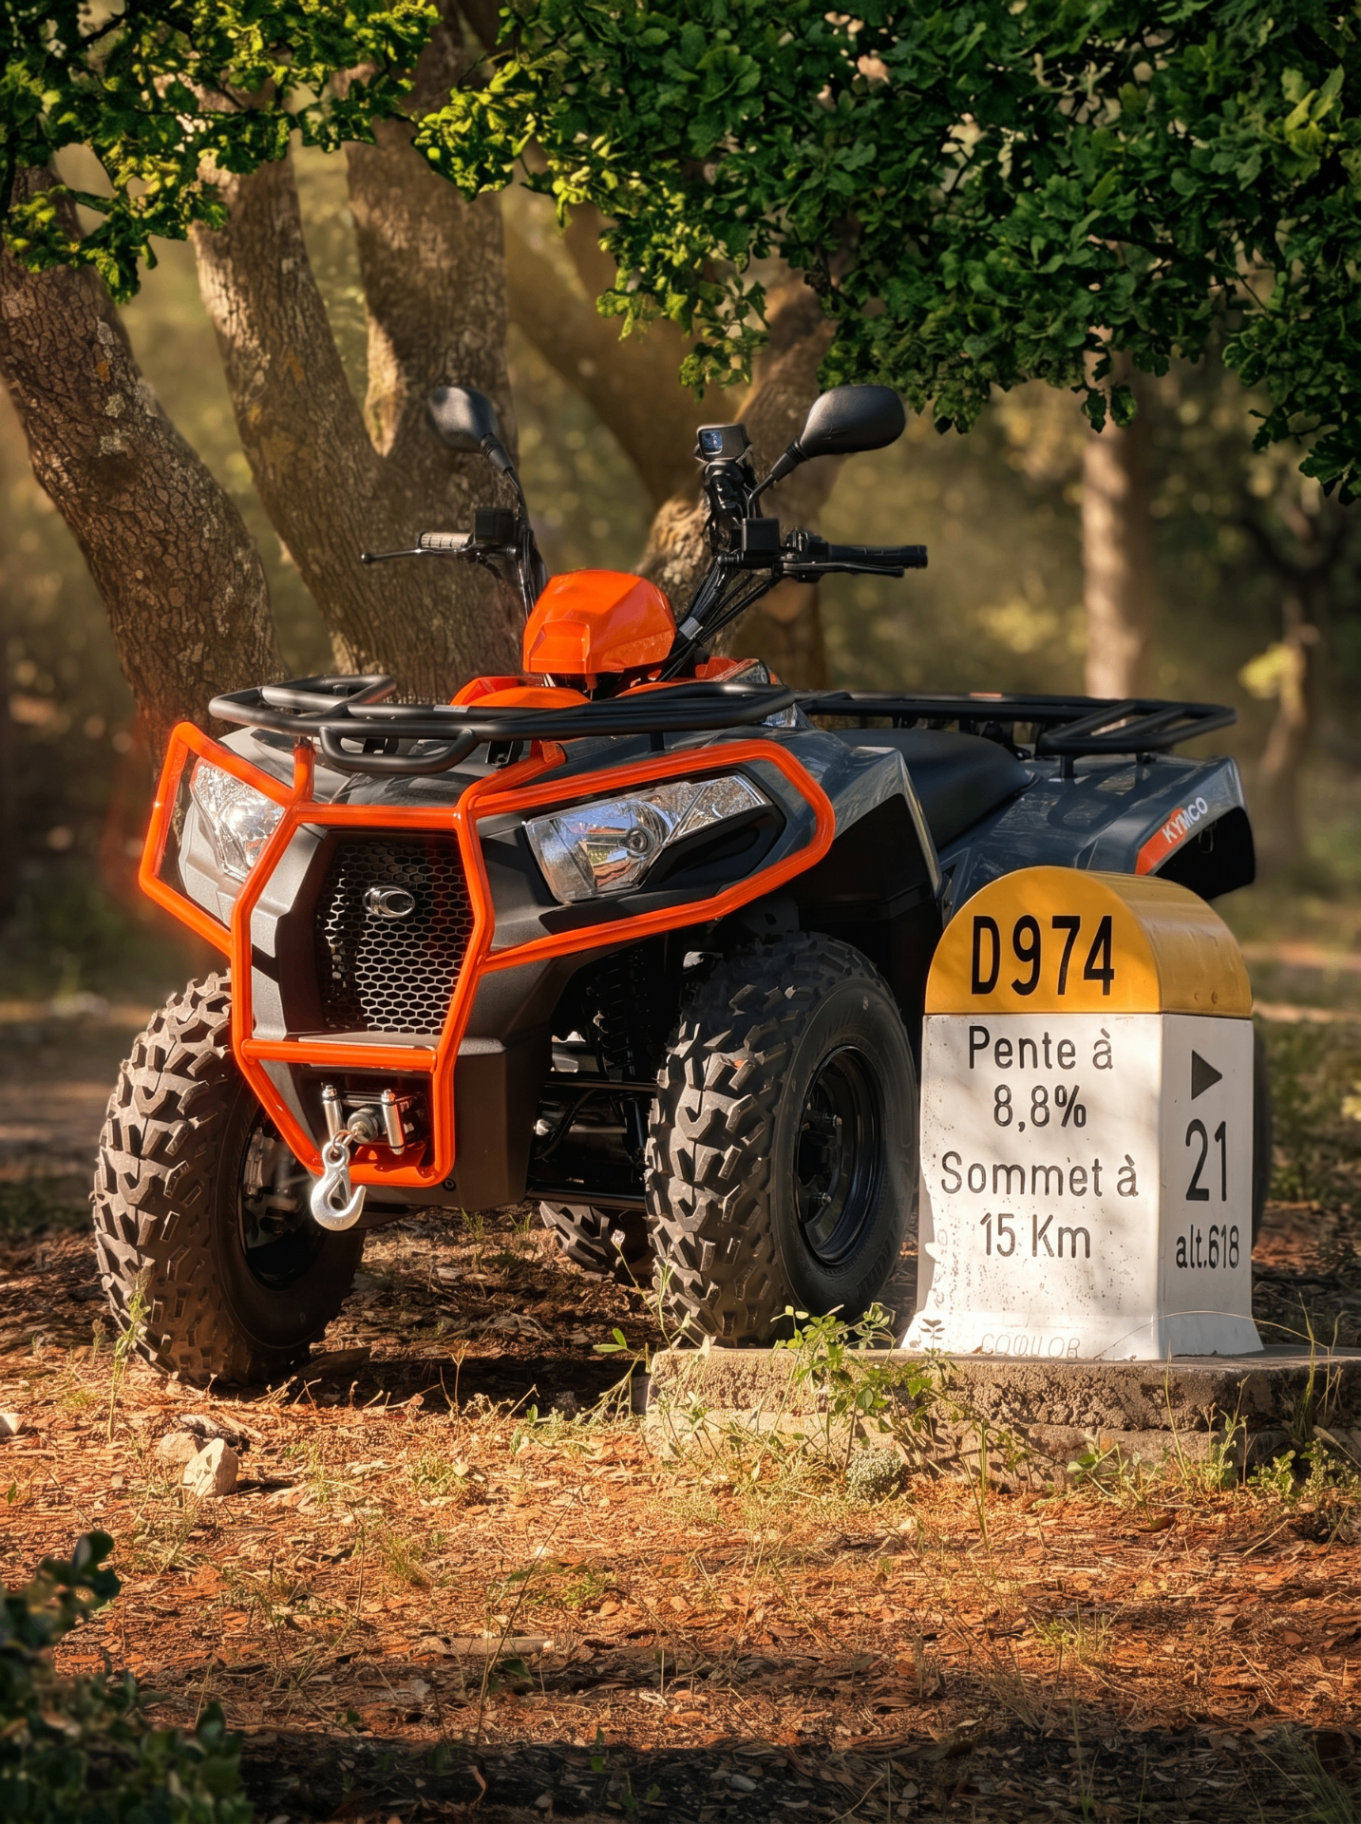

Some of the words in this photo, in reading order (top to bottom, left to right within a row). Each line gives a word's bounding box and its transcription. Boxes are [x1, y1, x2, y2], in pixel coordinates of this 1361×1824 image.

[1161, 797, 1208, 844] KYMCO
[971, 915, 1115, 996] D974
[968, 1026, 1076, 1070] Pente
[1092, 1028, 1114, 1070] à
[993, 1084, 1087, 1133] 8,8%
[941, 1151, 1103, 1197] Sommet
[1117, 1154, 1139, 1198] à
[1185, 1119, 1227, 1202] 21
[980, 1212, 1016, 1257] 15
[1032, 1214, 1091, 1259] Km
[1176, 1224, 1240, 1270] alt.618
